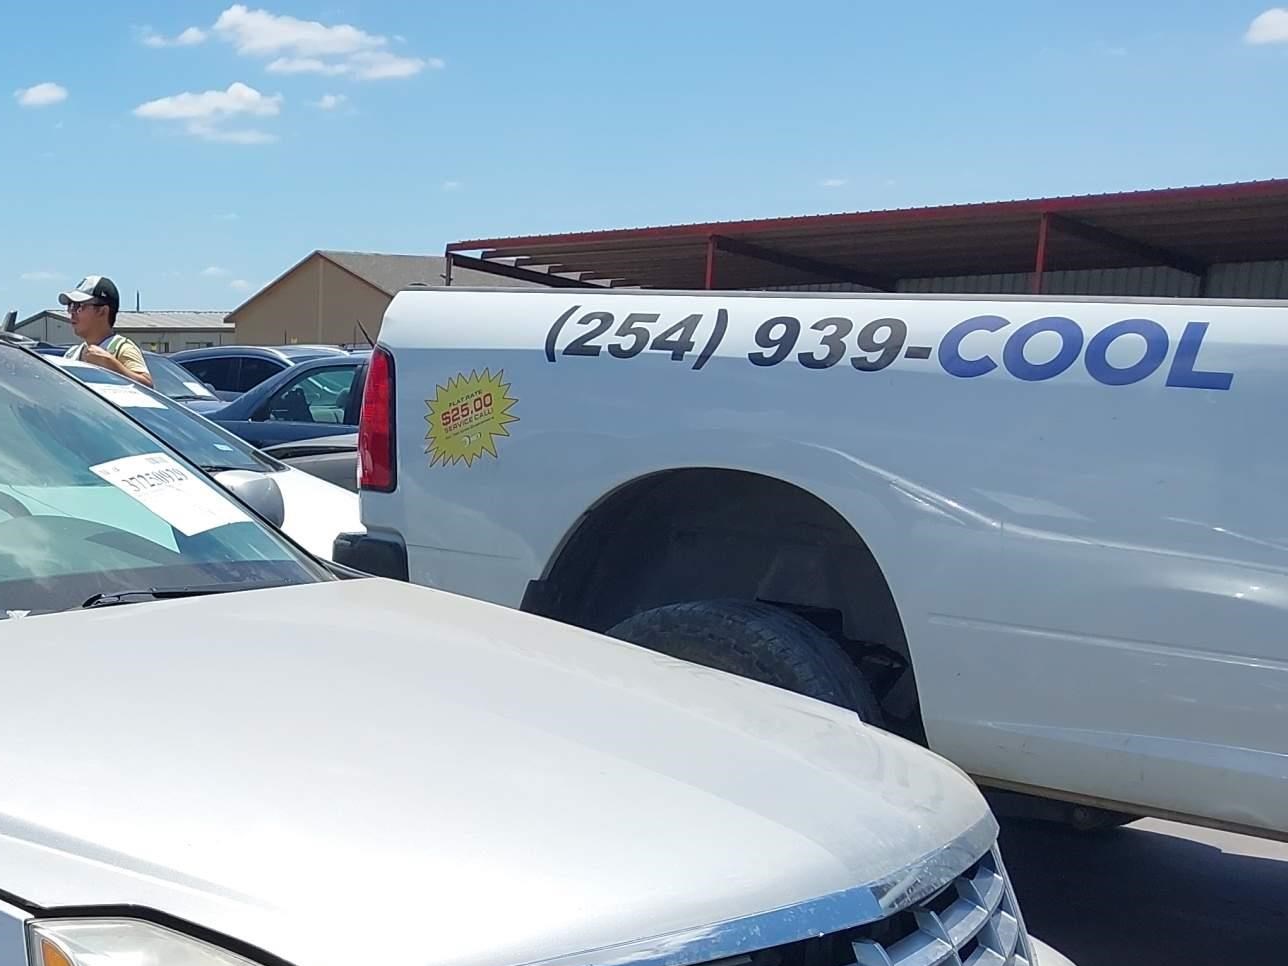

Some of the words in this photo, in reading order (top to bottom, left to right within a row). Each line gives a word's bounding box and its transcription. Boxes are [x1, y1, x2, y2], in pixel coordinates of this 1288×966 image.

[545, 304, 729, 371] (254)
[747, 314, 1235, 391] 939-COOL
[444, 416, 473, 433] SERVICE
